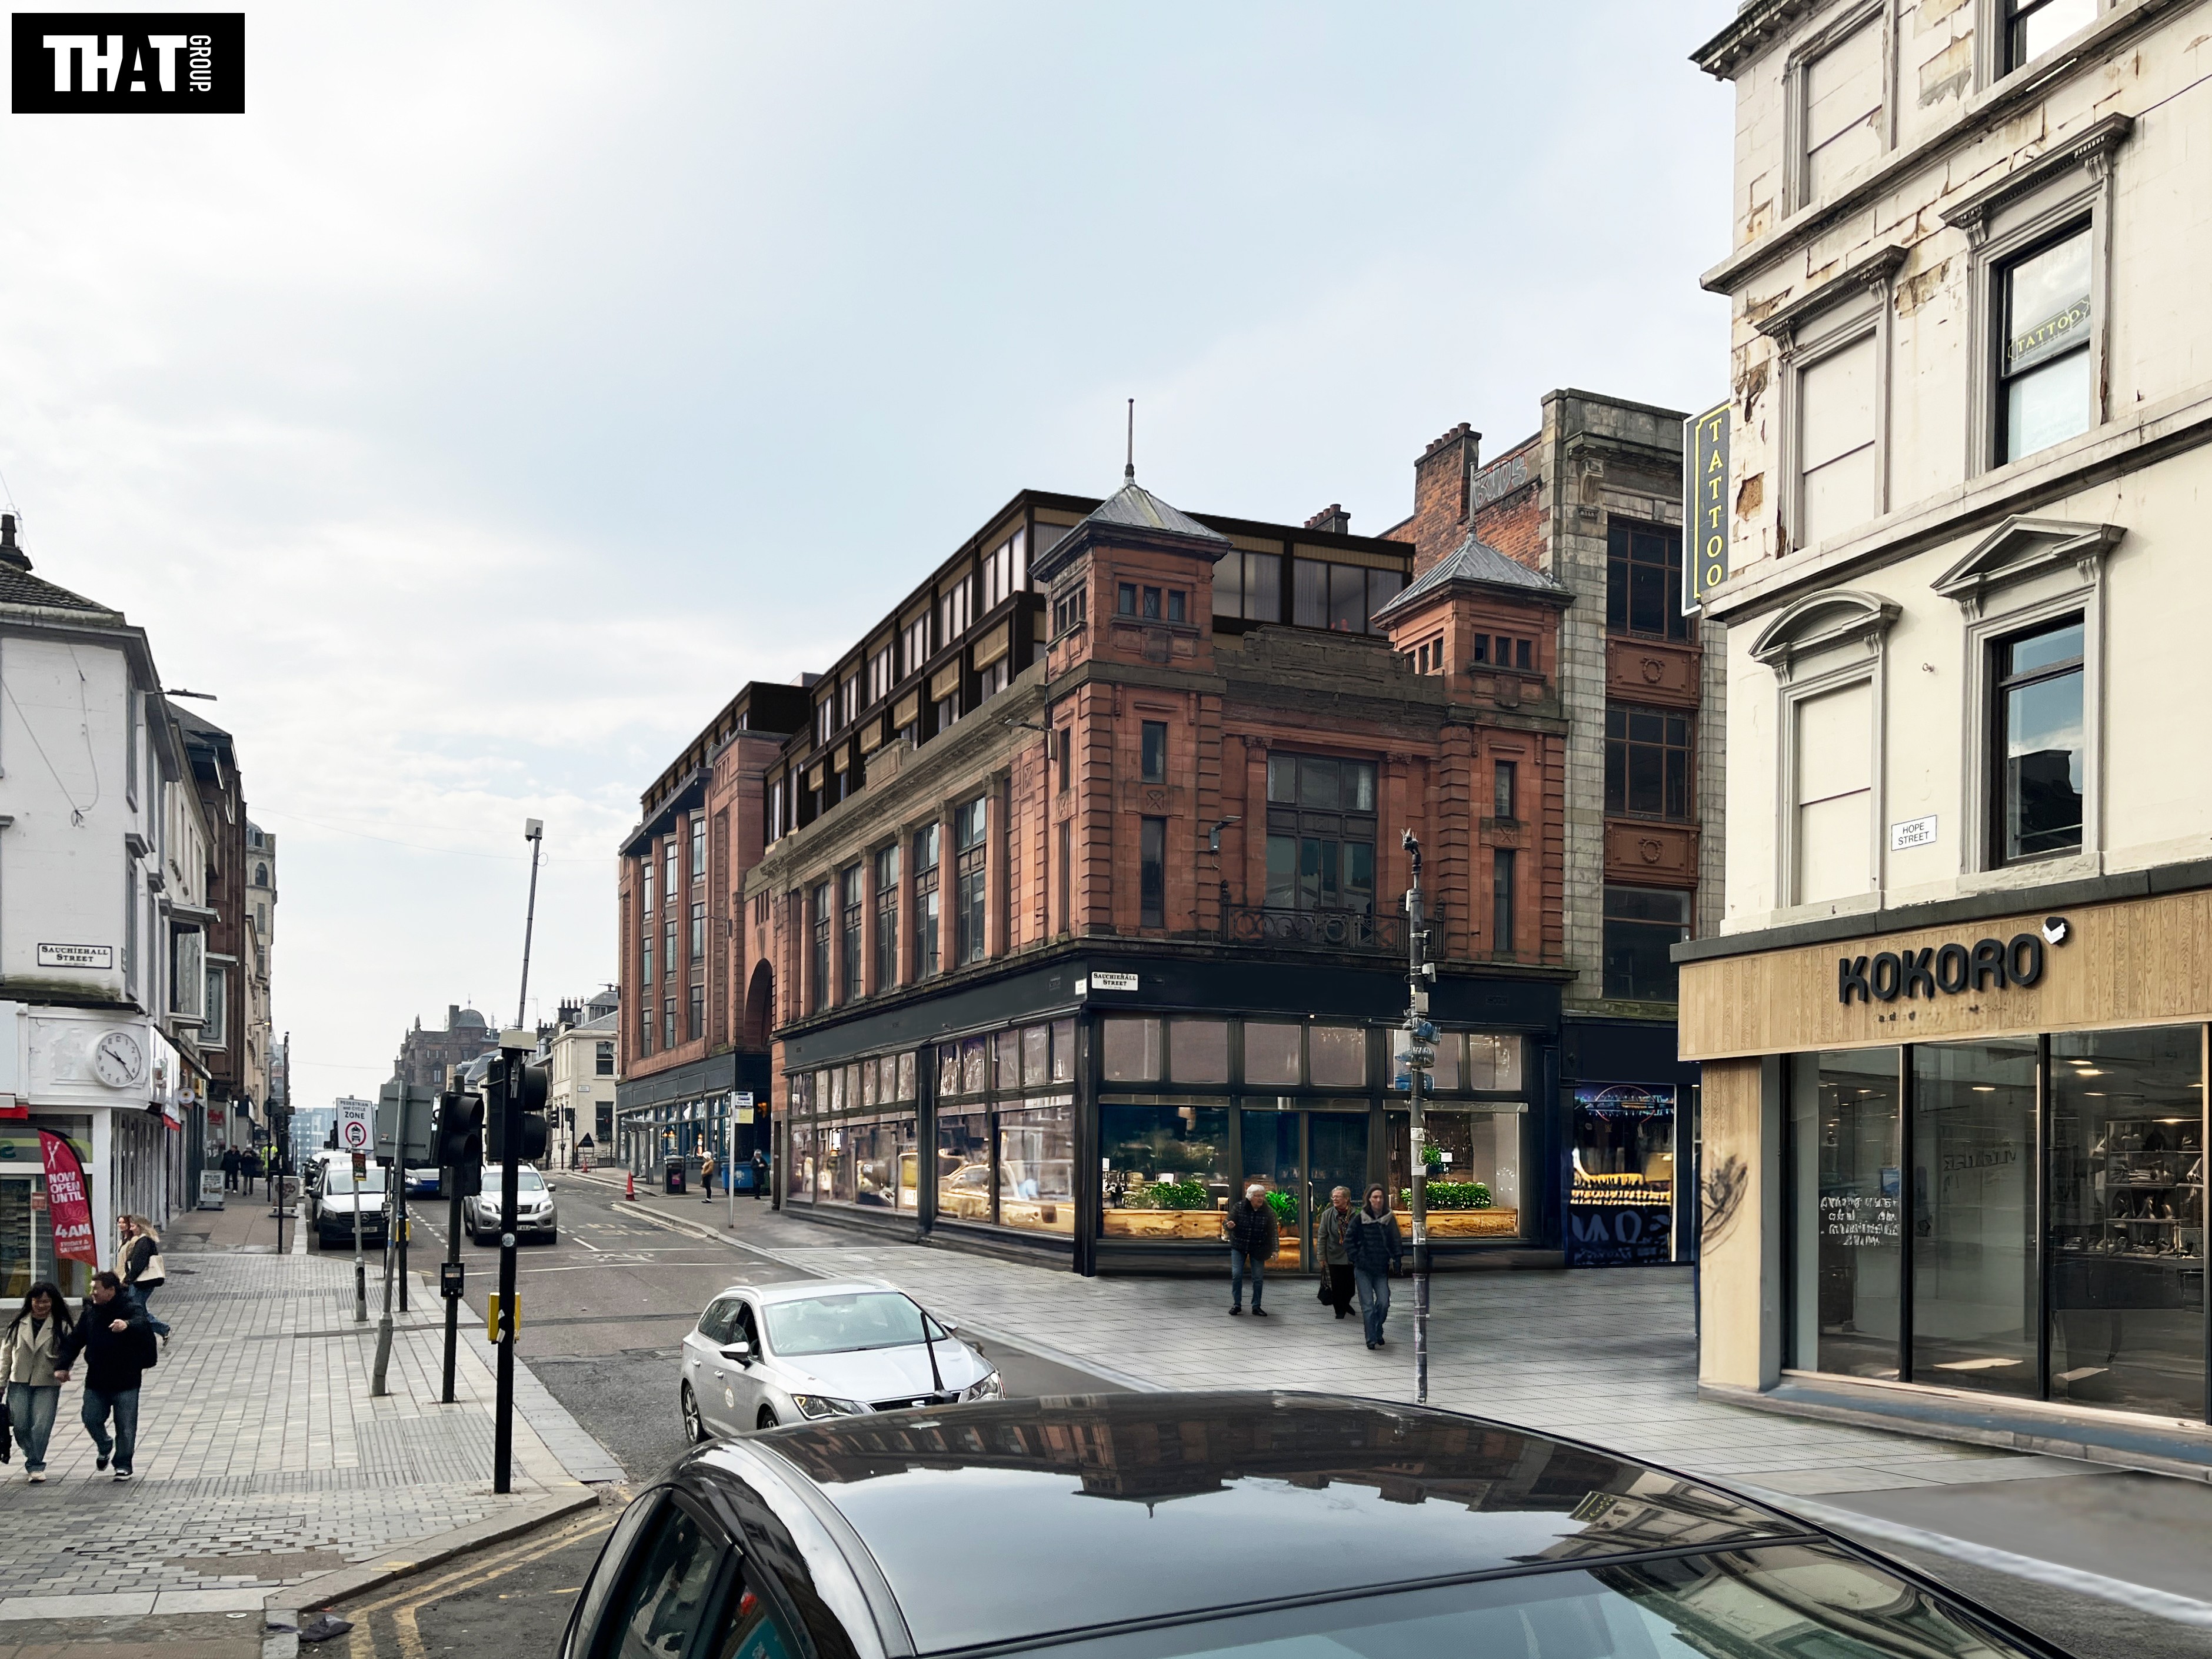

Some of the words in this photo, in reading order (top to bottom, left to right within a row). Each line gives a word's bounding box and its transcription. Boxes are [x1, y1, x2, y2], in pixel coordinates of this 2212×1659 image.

[2018, 310, 2080, 352] TATTOO
[1706, 417, 1723, 587] TATTOO
[1903, 822, 1925, 834] HOPE
[1898, 831, 1930, 845] STREET
[42, 945, 108, 955] SAUCHIEHALL
[56, 954, 94, 962] STREET
[1839, 933, 2043, 1004] KOKORO
[1094, 972, 1137, 981] SAUCHIEHALL
[345, 1111, 365, 1120] ZONE
[48, 1171, 76, 1184] NOW
[50, 1181, 80, 1194] OPEN
[51, 1192, 85, 1204] UNTIL
